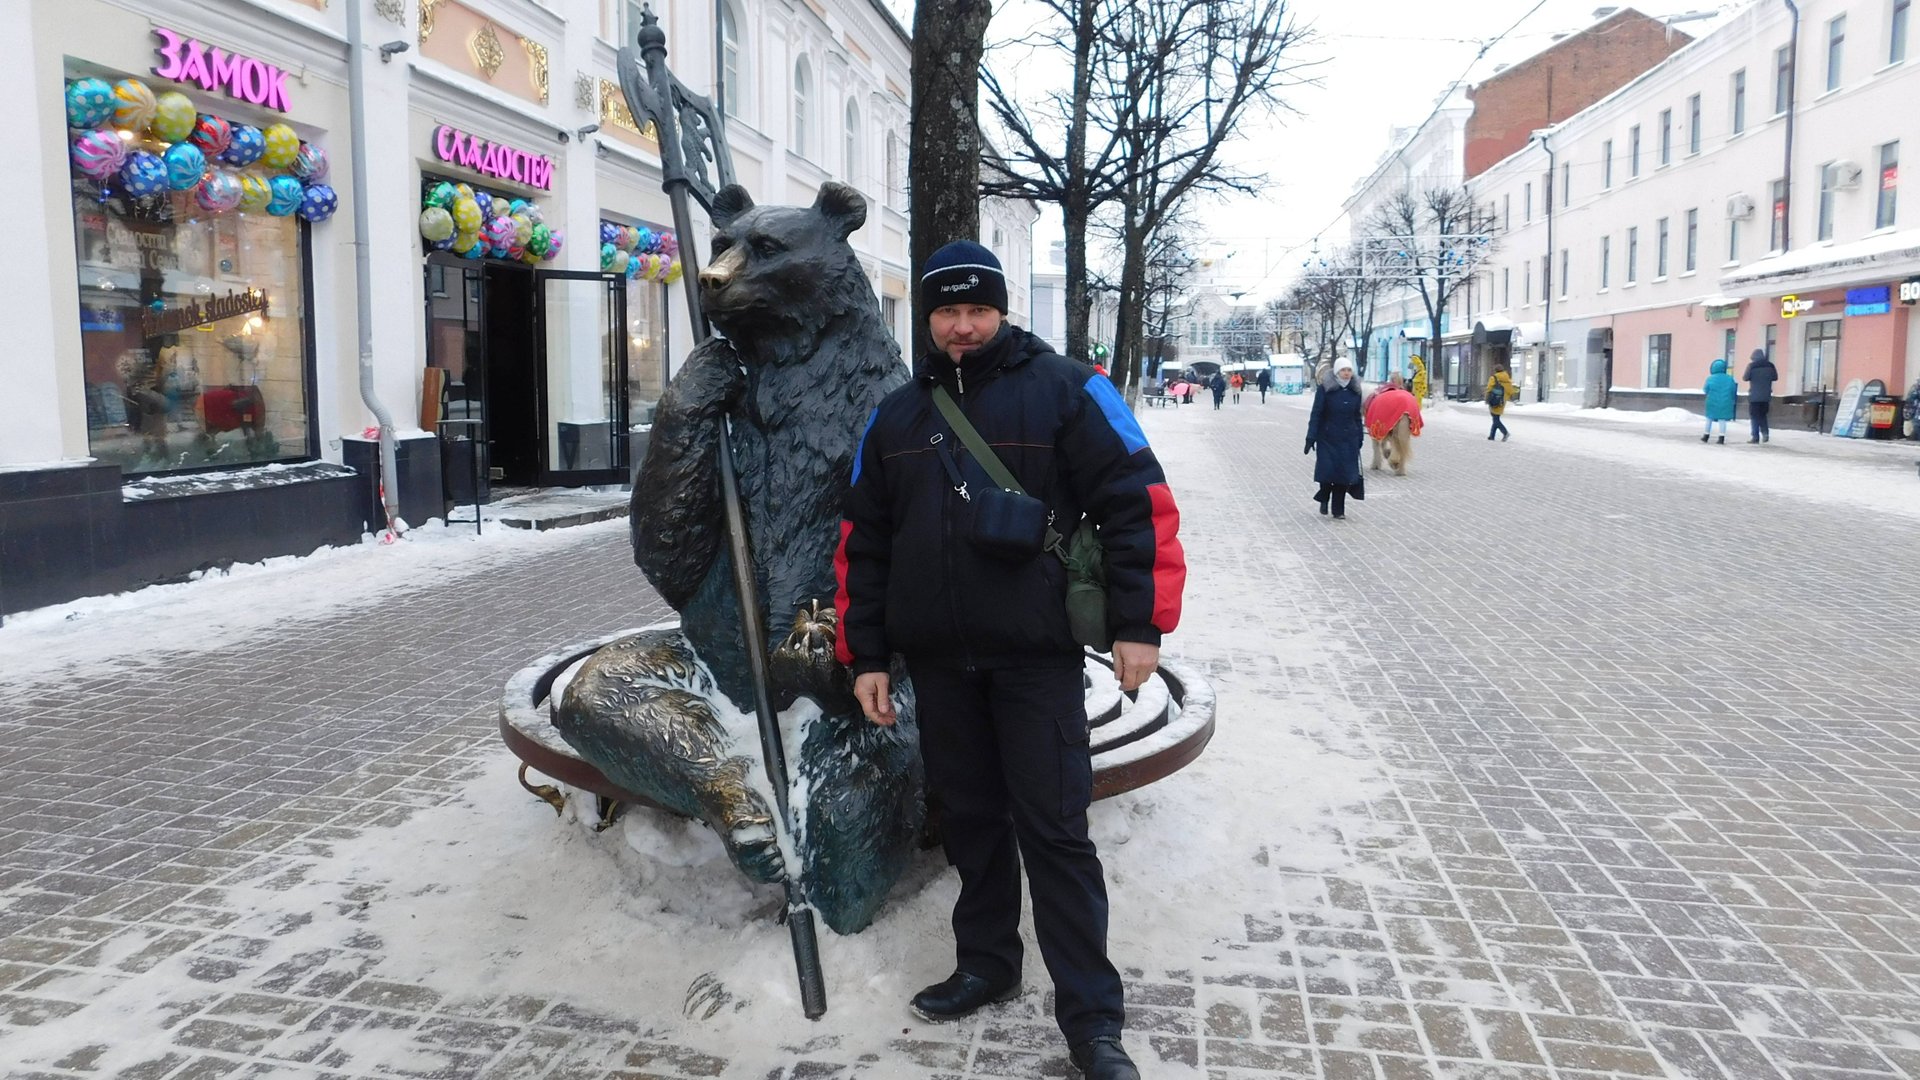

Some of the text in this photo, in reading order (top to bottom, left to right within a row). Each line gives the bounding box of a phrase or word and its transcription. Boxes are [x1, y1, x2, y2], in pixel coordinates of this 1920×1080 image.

[152, 28, 292, 112] ЗАМОК
[435, 125, 554, 190] СЛАДОСТЕЙ
[940, 282, 971, 293] Navigator
